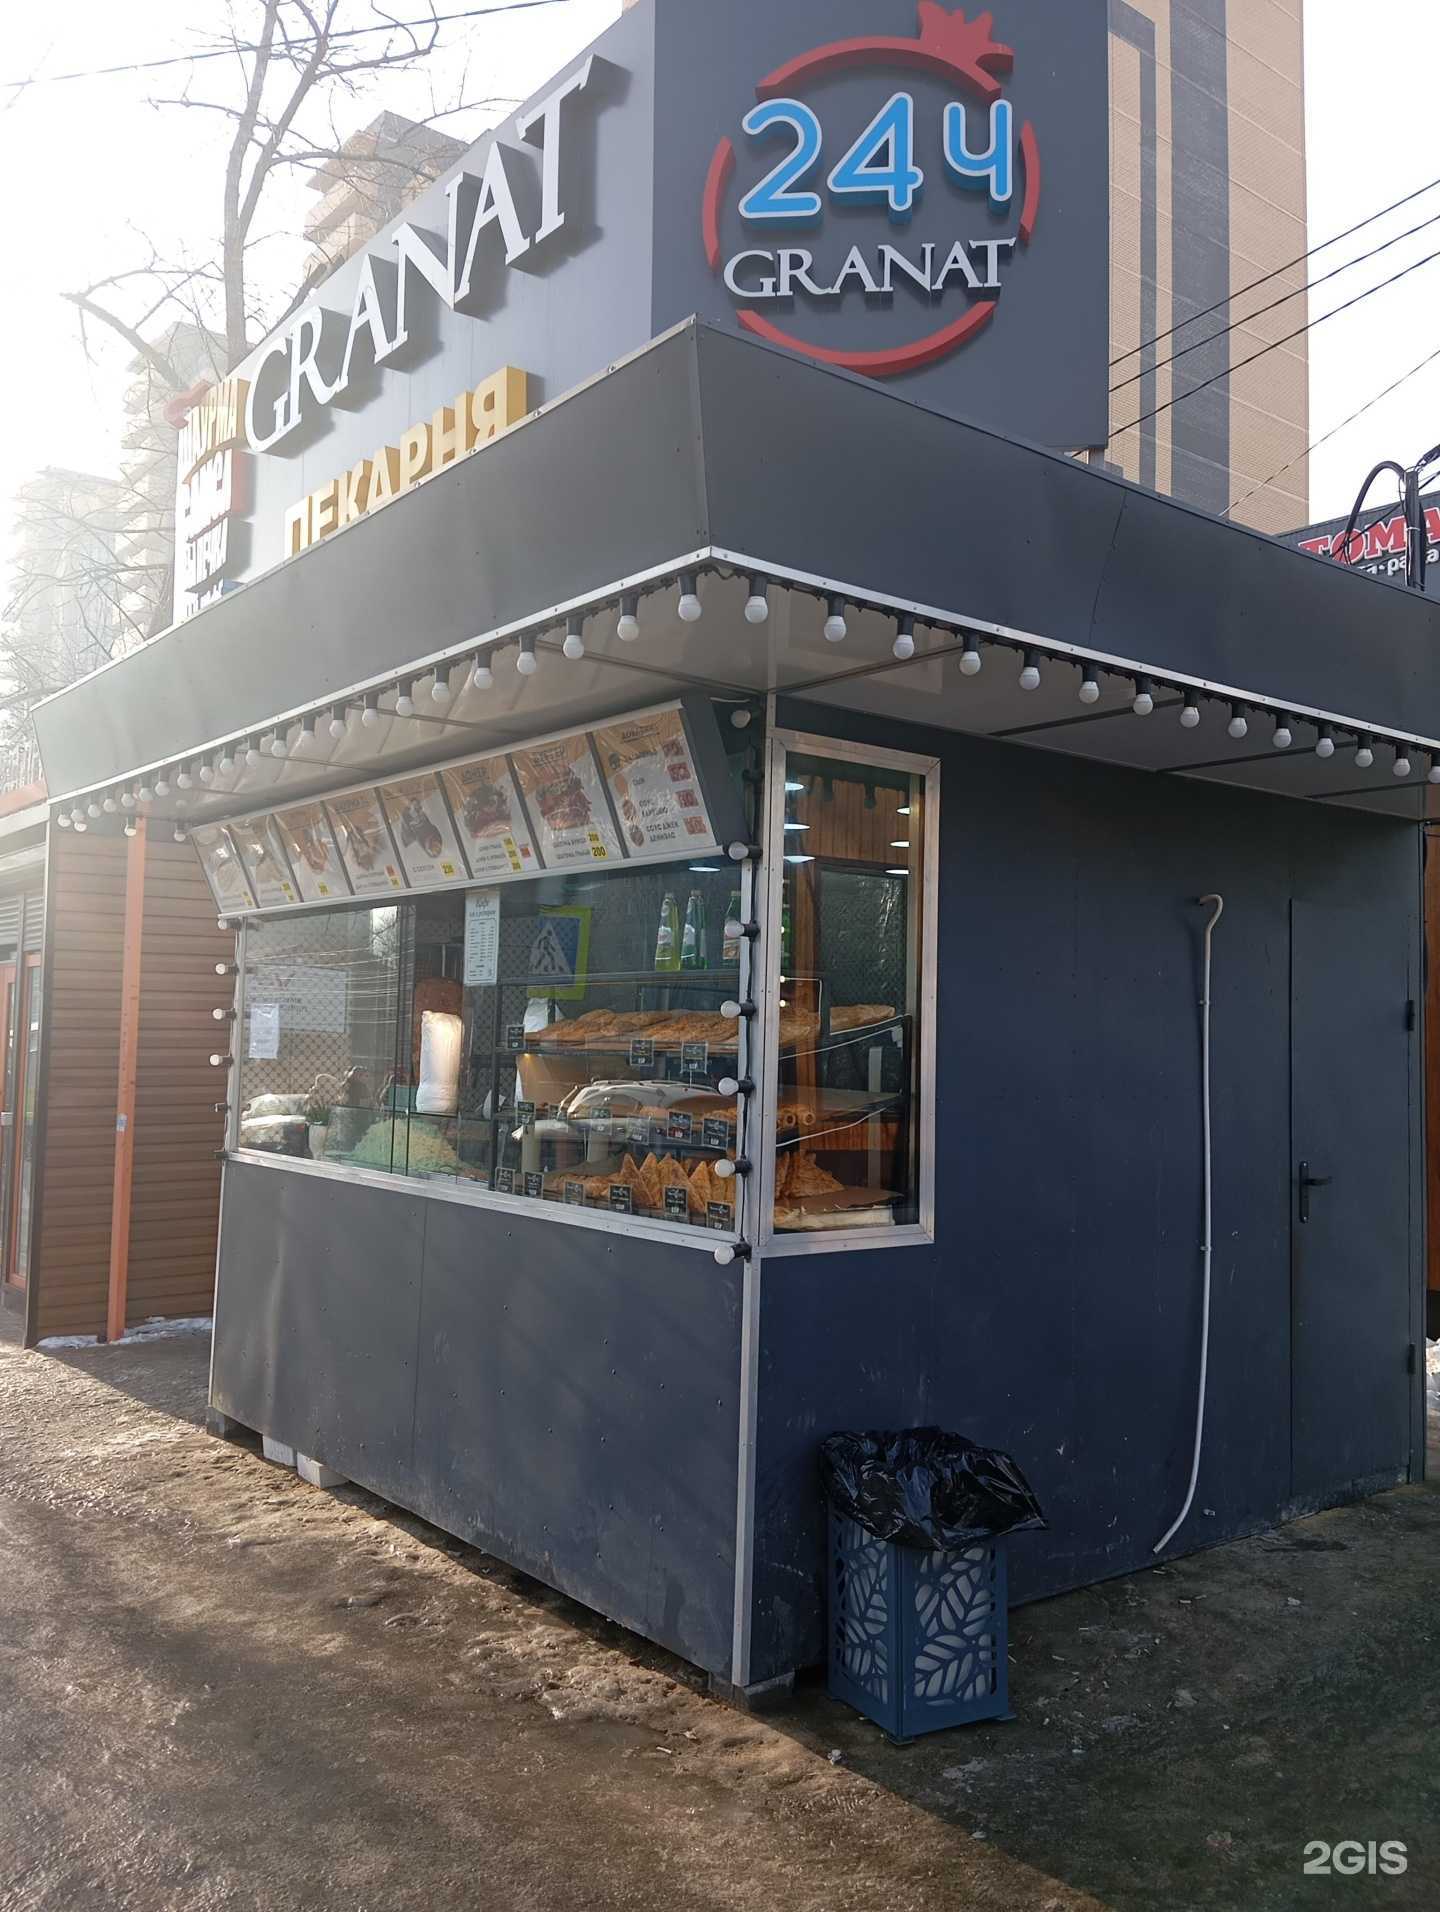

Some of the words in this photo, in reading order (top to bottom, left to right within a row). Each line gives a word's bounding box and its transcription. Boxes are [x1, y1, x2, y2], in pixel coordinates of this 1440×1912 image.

[244, 54, 596, 453] GRANAT
[723, 237, 1016, 298] GRANAT
[284, 366, 510, 560] ПЕКАРНЯ
